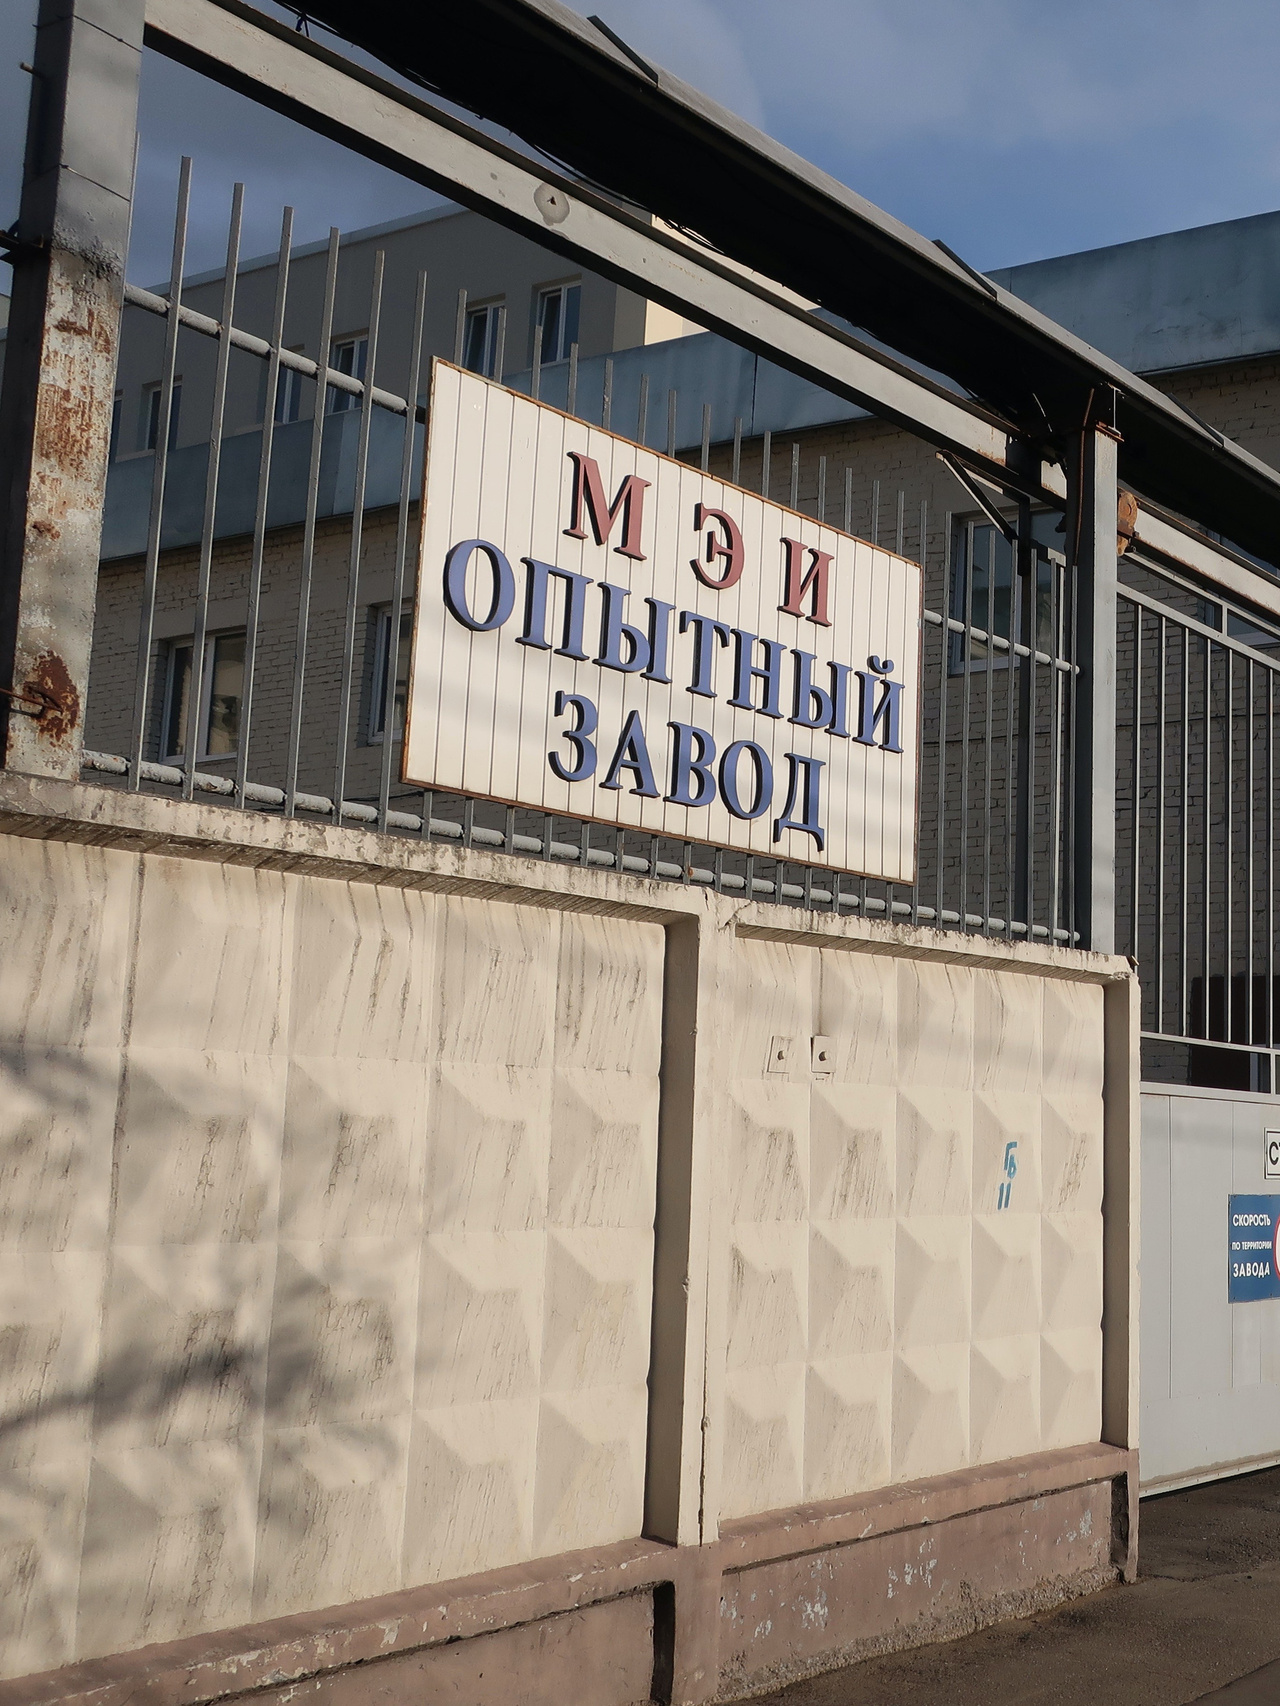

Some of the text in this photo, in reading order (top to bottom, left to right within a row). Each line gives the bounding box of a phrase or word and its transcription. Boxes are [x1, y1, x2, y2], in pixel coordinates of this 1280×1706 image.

[562, 451, 834, 627] МЭИ
[443, 539, 906, 754] ОПЫТНЫЙ
[548, 690, 827, 852] ЗАВОД
[1232, 1241, 1272, 1250] ПО ТЕРРИТОРИИ
[1233, 1214, 1271, 1227] СКОРОСТЬ
[1233, 1262, 1270, 1278] ЗАВОДА
